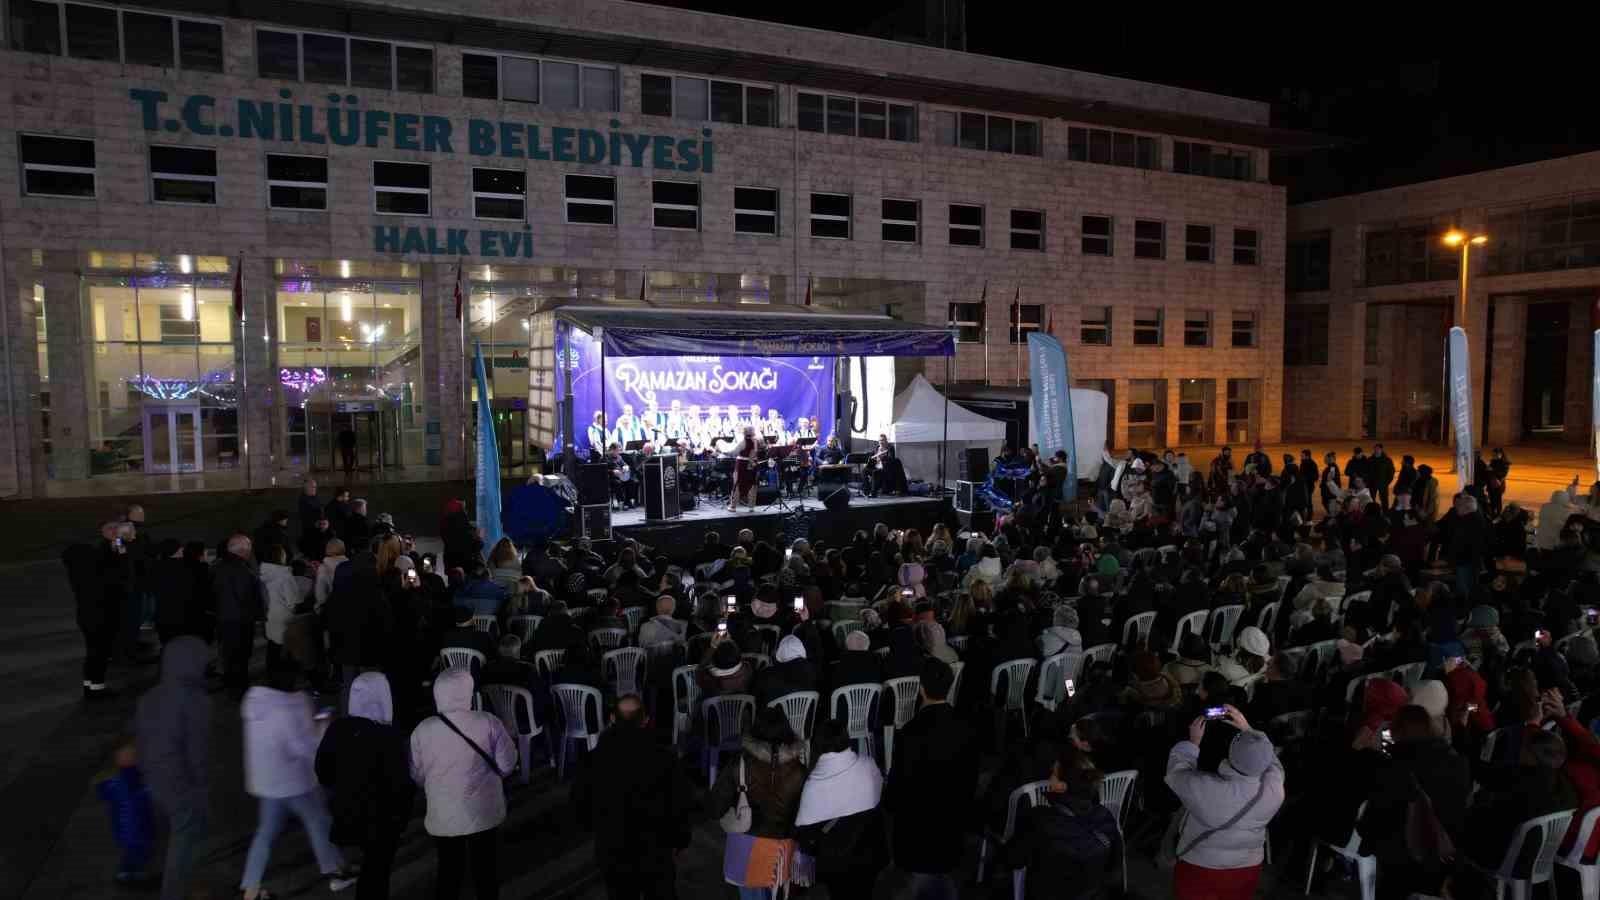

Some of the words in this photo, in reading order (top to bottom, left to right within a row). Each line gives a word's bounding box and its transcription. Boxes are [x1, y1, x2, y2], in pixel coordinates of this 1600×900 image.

[468, 119, 713, 173] BELEDİYESİ
[375, 225, 471, 257] HALK
[480, 225, 533, 257] EVİ
[616, 364, 706, 402] RAMAZAN
[708, 364, 778, 393] SOKAĞI
